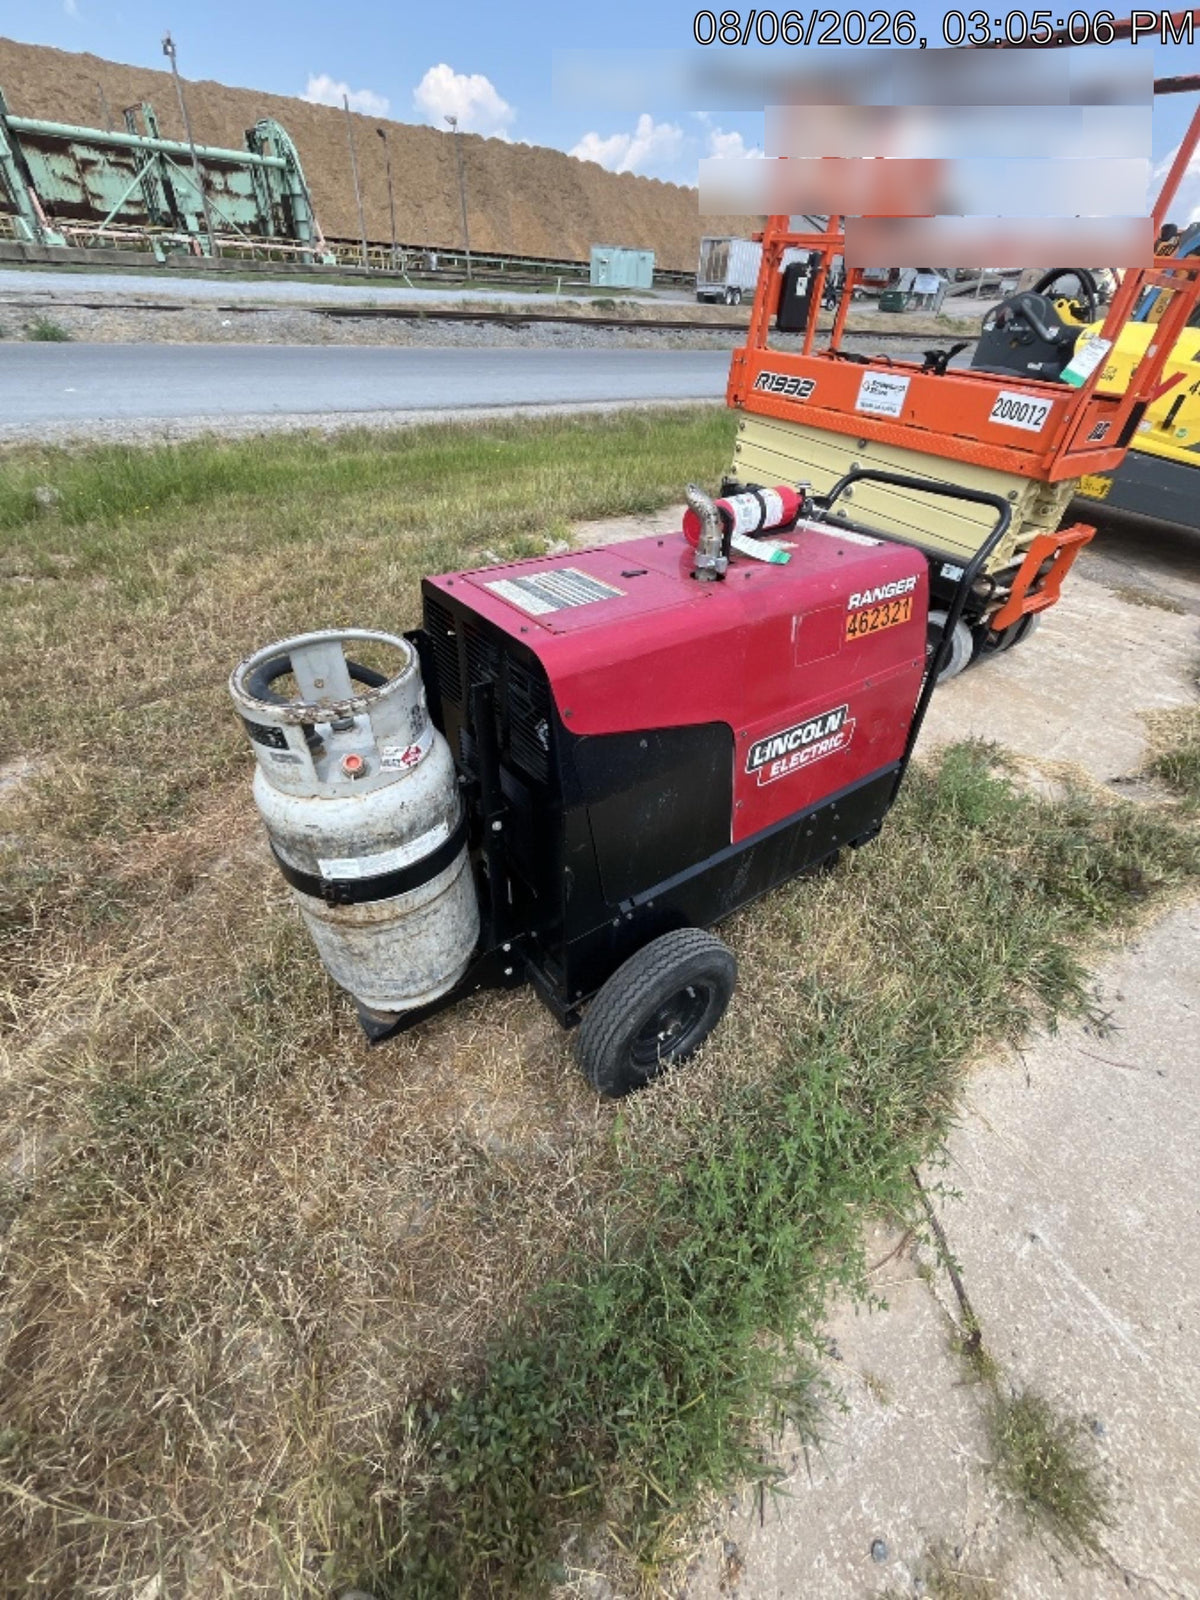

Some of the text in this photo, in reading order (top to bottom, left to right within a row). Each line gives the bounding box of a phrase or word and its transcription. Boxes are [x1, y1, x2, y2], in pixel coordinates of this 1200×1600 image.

[753, 371, 816, 399] R1932
[991, 397, 1047, 426] 200012
[847, 575, 917, 611] RANGER
[847, 597, 910, 636] 462321
[752, 711, 842, 767] LINCOLN
[769, 732, 845, 778] ELECTRIC
